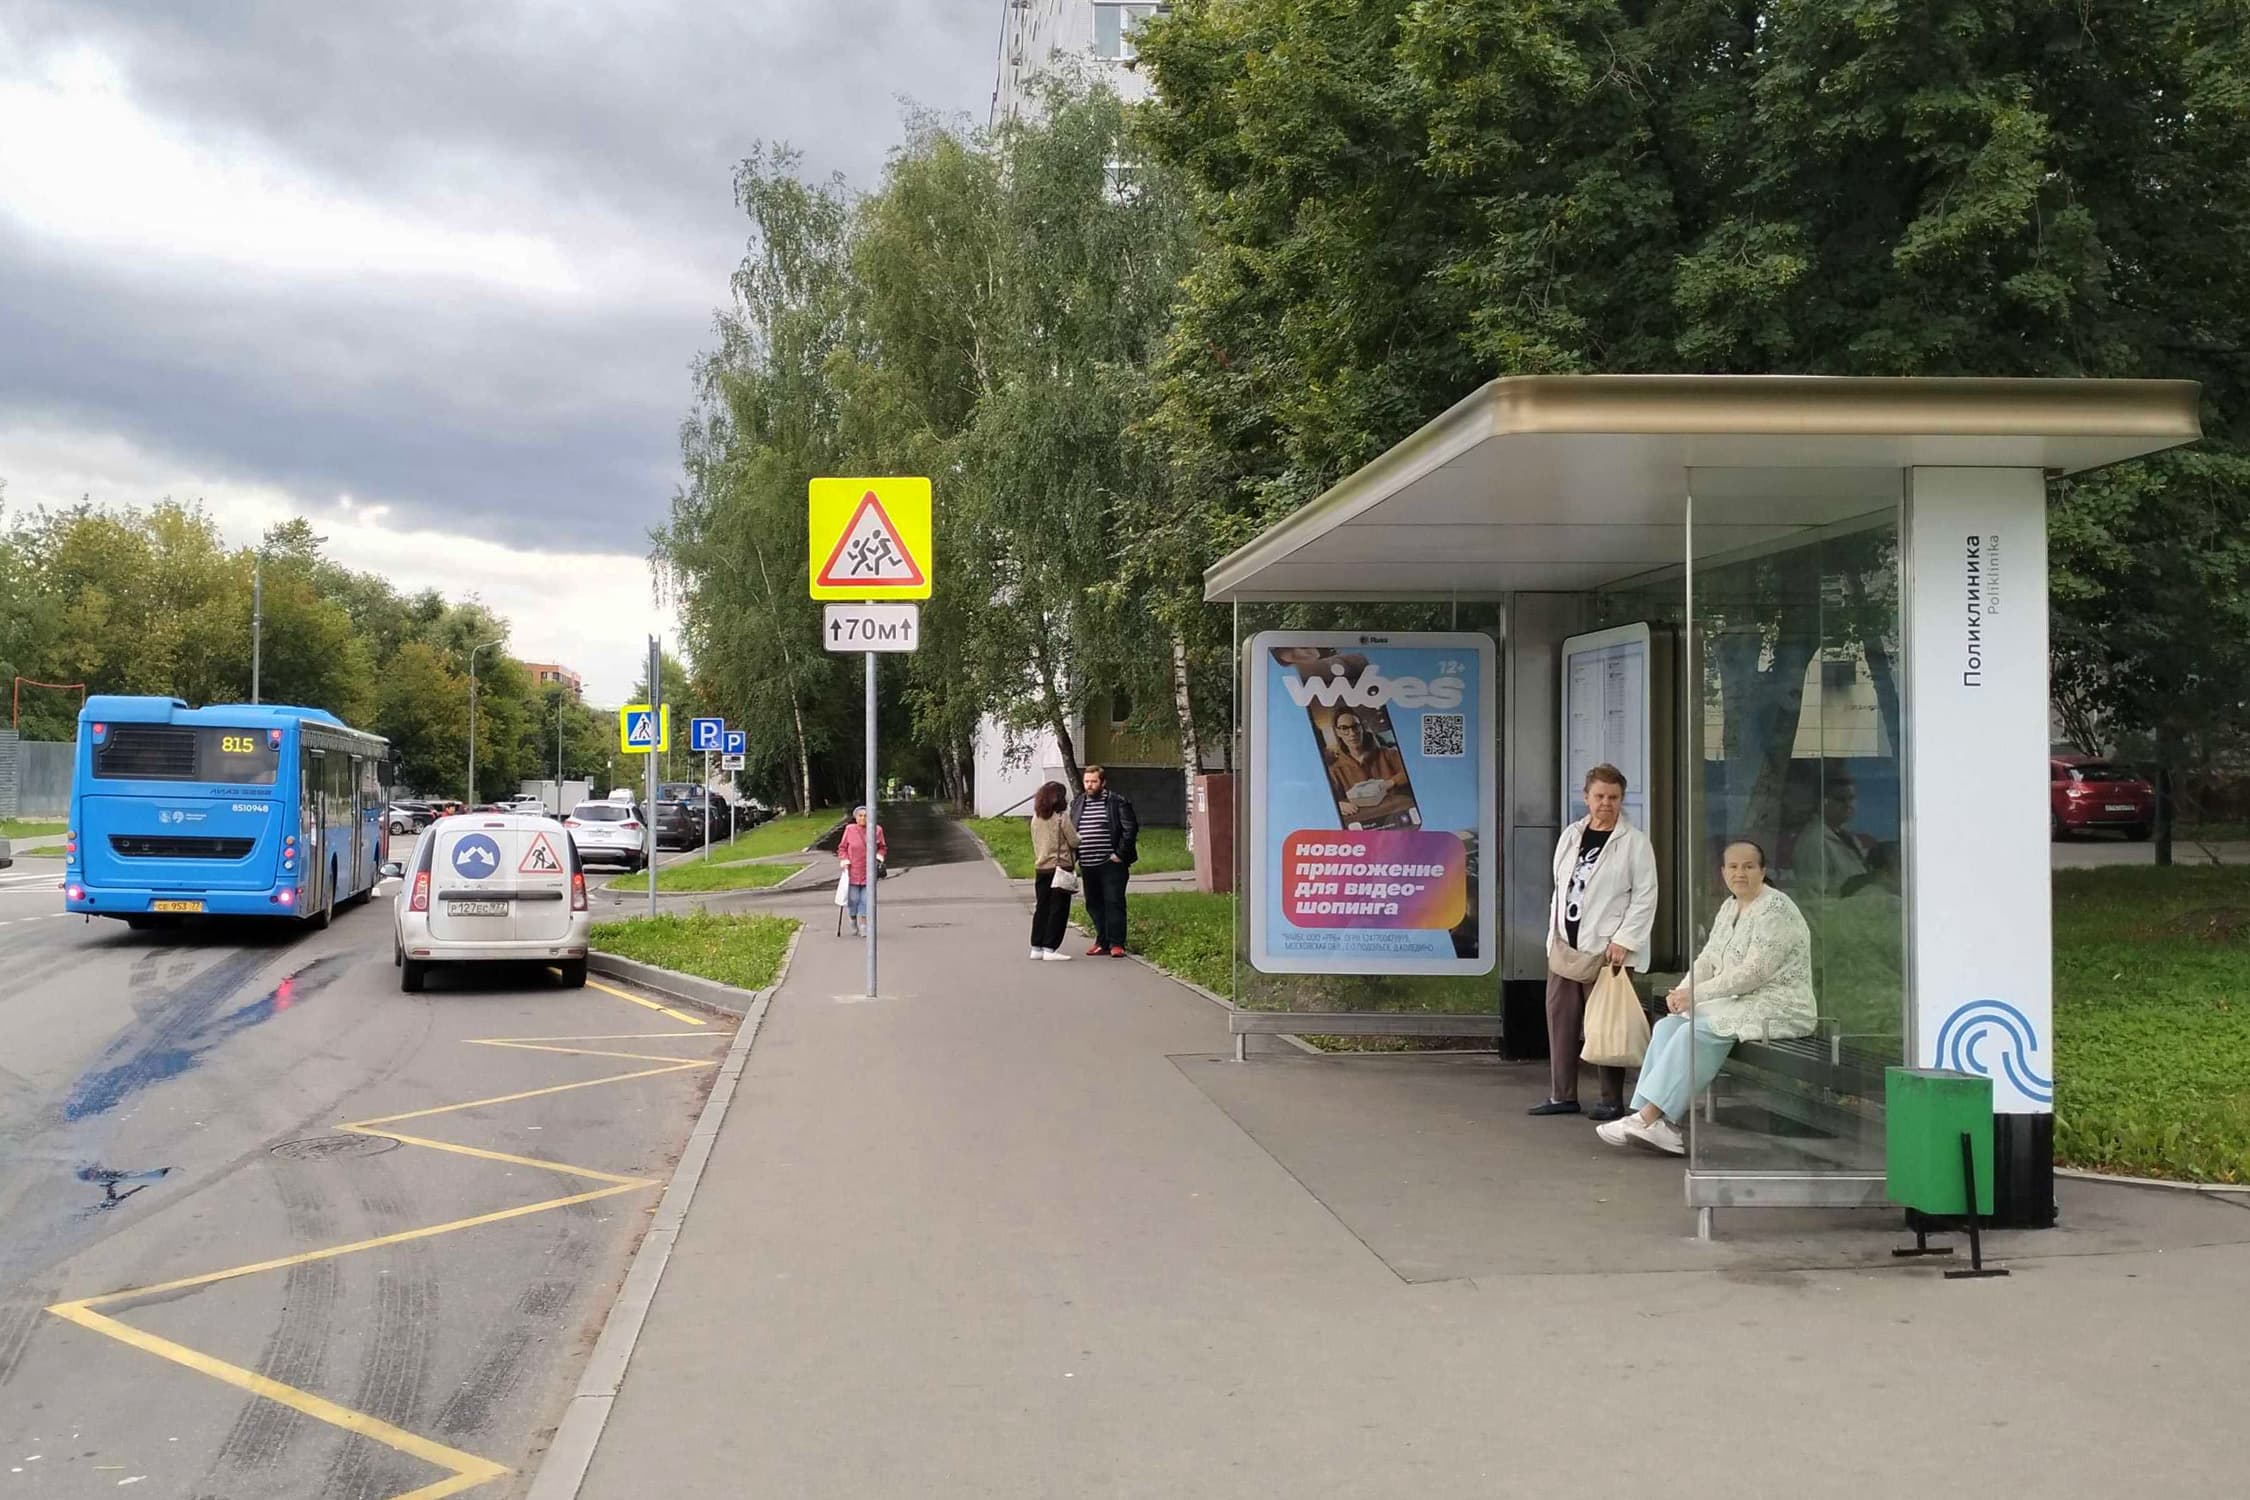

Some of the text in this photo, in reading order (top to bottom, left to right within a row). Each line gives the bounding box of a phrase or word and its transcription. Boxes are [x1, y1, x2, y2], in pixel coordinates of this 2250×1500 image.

[1986, 535, 2000, 614] Poliklinika
[1964, 535, 1981, 686] Поликлиника
[1439, 660, 1466, 674] 12+
[700, 722, 718, 747] P
[728, 734, 741, 751] P
[222, 736, 254, 752] 815
[232, 804, 269, 812] 8510948
[1295, 843, 1367, 857] новое
[1295, 863, 1445, 880] приложение
[1294, 882, 1425, 898] для видео-
[1295, 901, 1399, 915] шопинга
